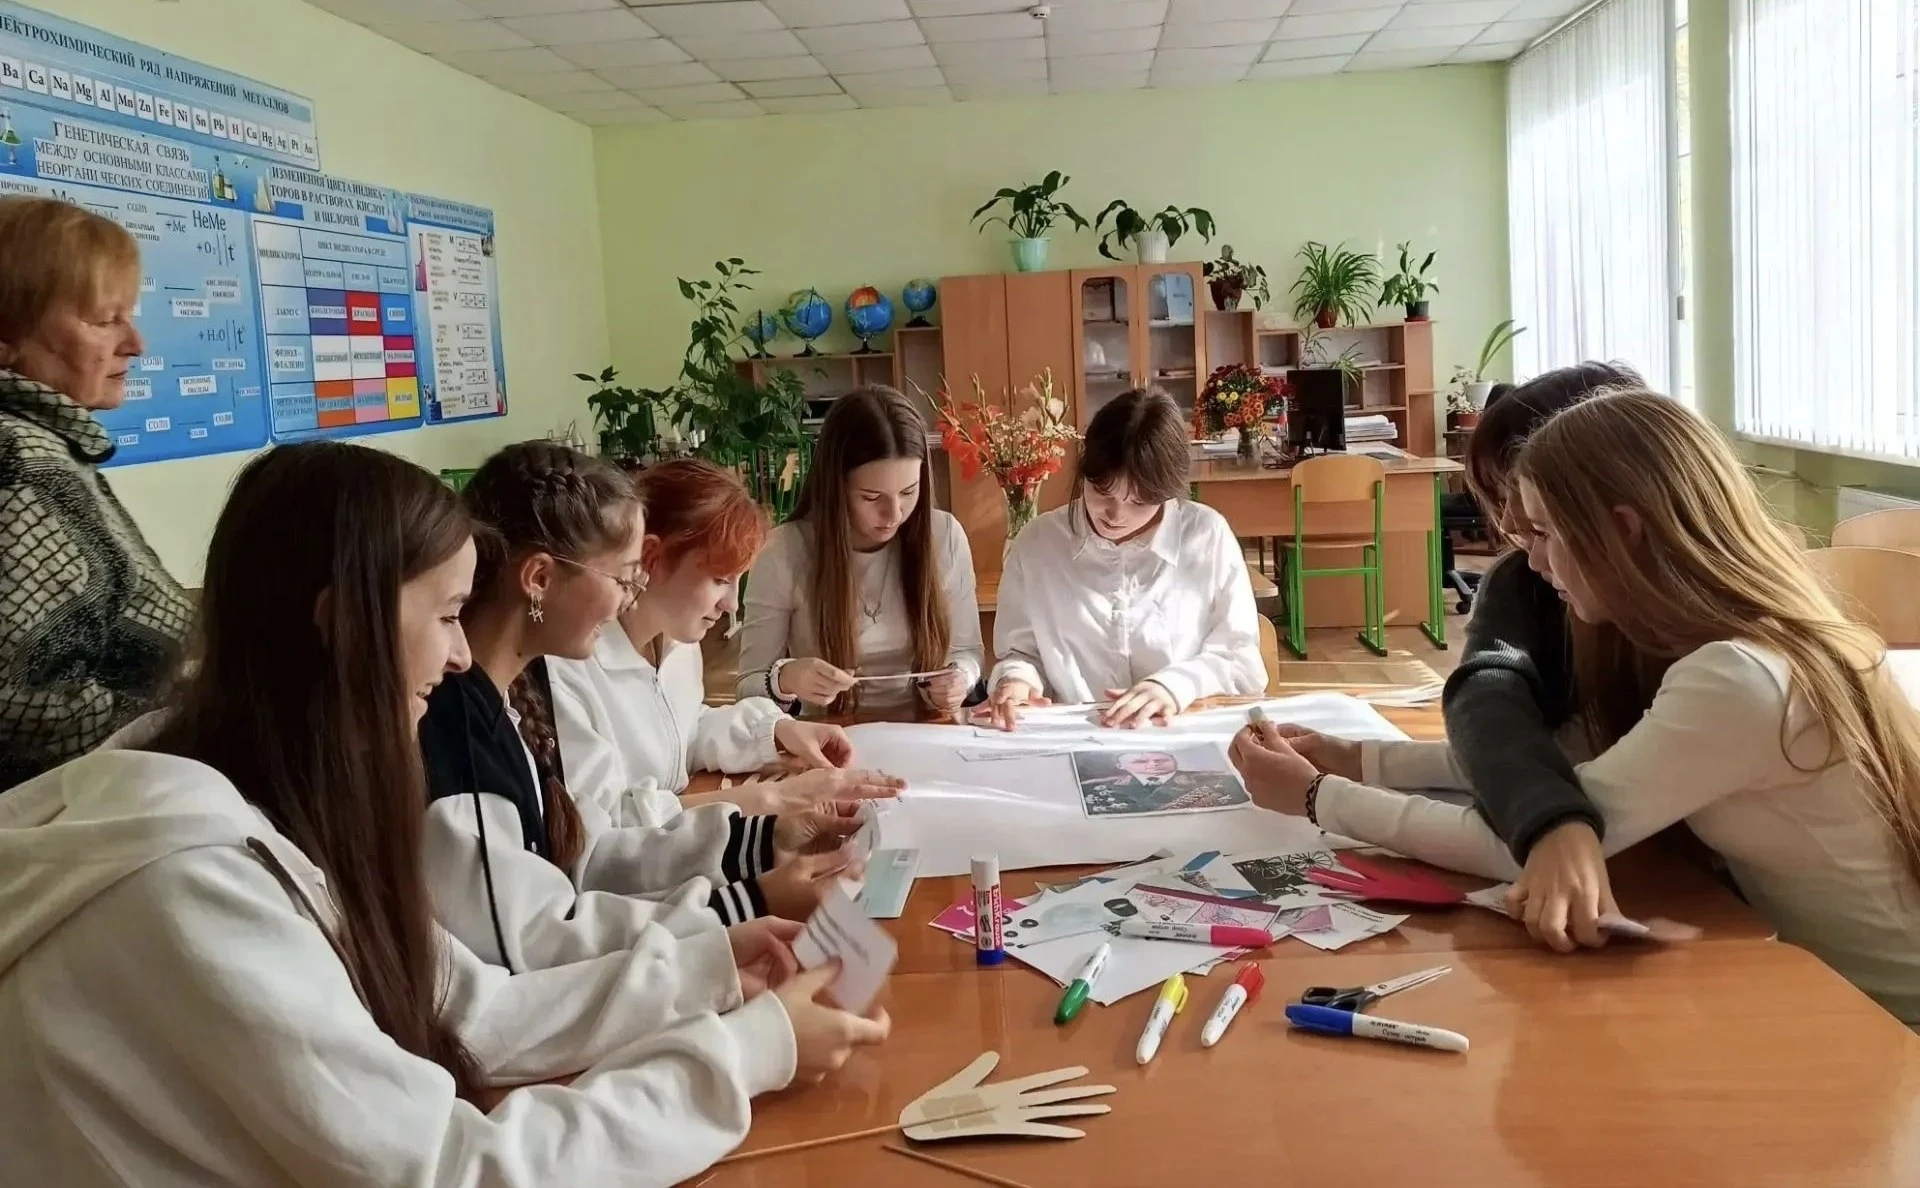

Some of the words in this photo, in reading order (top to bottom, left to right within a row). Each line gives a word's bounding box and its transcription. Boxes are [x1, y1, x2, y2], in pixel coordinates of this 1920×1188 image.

[0, 16, 135, 67] ЕКТРОХИМИЧЕСКИЙ
[140, 58, 161, 77] РЯД
[165, 66, 236, 97] НАПРЯЖЕНИЙ
[242, 89, 289, 114] МЕТАЛЛОВ
[2, 62, 19, 79] Ba
[29, 69, 45, 85] Ca
[53, 75, 69, 91] Na
[75, 81, 93, 101] Mg
[100, 88, 111, 102] Al
[118, 93, 133, 108] Mn
[138, 98, 152, 113] Zn
[159, 104, 170, 118] Fe
[177, 109, 188, 123] Ni
[196, 115, 206, 128] Sn
[213, 118, 225, 131] Pb
[232, 123, 239, 136] H
[246, 126, 257, 140] Cu
[262, 131, 273, 147] Hg
[277, 135, 287, 149] Ag
[291, 139, 299, 151] Pt
[34, 140, 79, 161] МЕЖДУ
[83, 150, 152, 174] ОСНОВНЫМИ
[156, 164, 207, 184] КЛАССАМИ
[52, 120, 150, 156] ГЕНЕТИЧЕСКАЯ
[156, 144, 189, 162] СВЯЗЬ
[270, 185, 300, 200] ТОРОВ
[301, 191, 308, 202] В
[309, 192, 354, 209] РАСТВОРАХ
[356, 200, 385, 216] КИСЛОТ
[272, 166, 325, 187] ИЗМЕНЕНИЯ
[326, 178, 351, 193] ЦВЕТА
[314, 211, 321, 222] И
[322, 211, 360, 228] ЩЕЛОЧЕЙ
[993, 887, 1001, 947] ErichKrause
